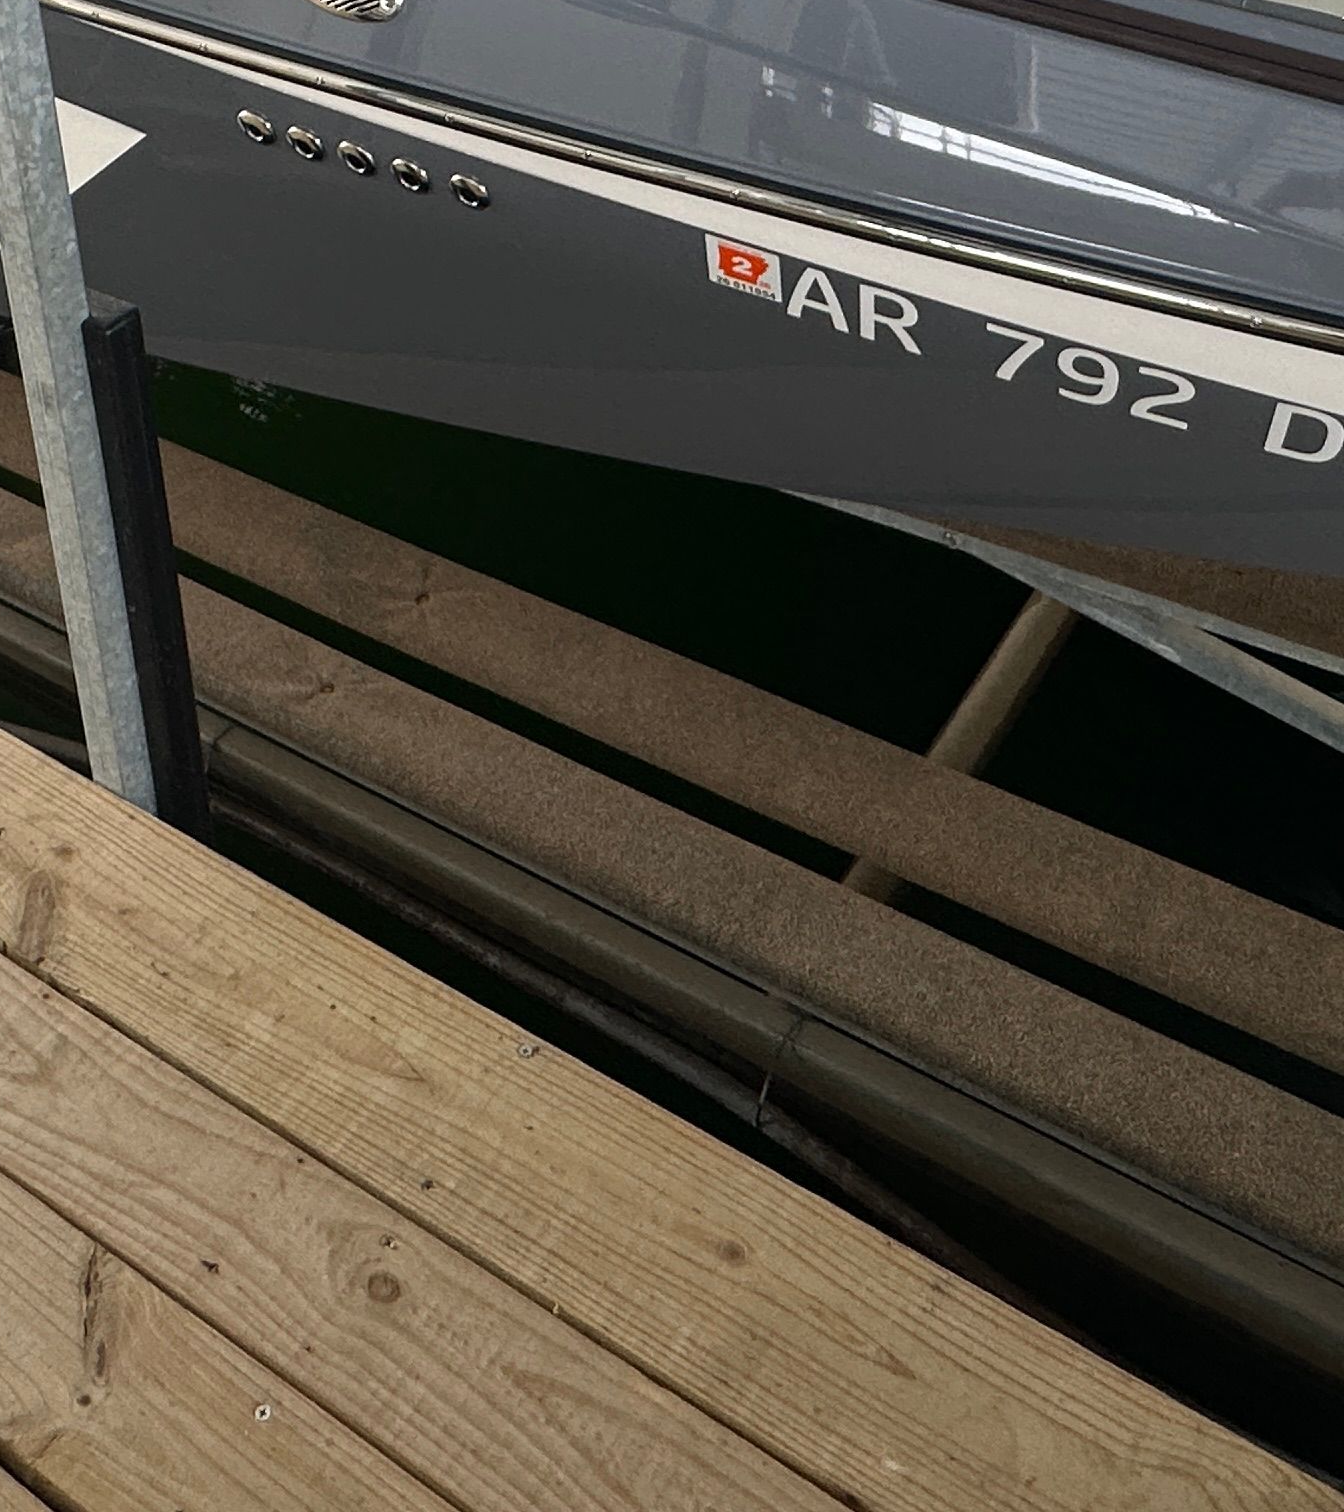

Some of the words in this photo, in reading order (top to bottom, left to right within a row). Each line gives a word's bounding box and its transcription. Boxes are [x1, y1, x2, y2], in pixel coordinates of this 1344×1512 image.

[730, 255, 753, 277] 2
[786, 267, 923, 355] AR
[985, 321, 1198, 431] 792
